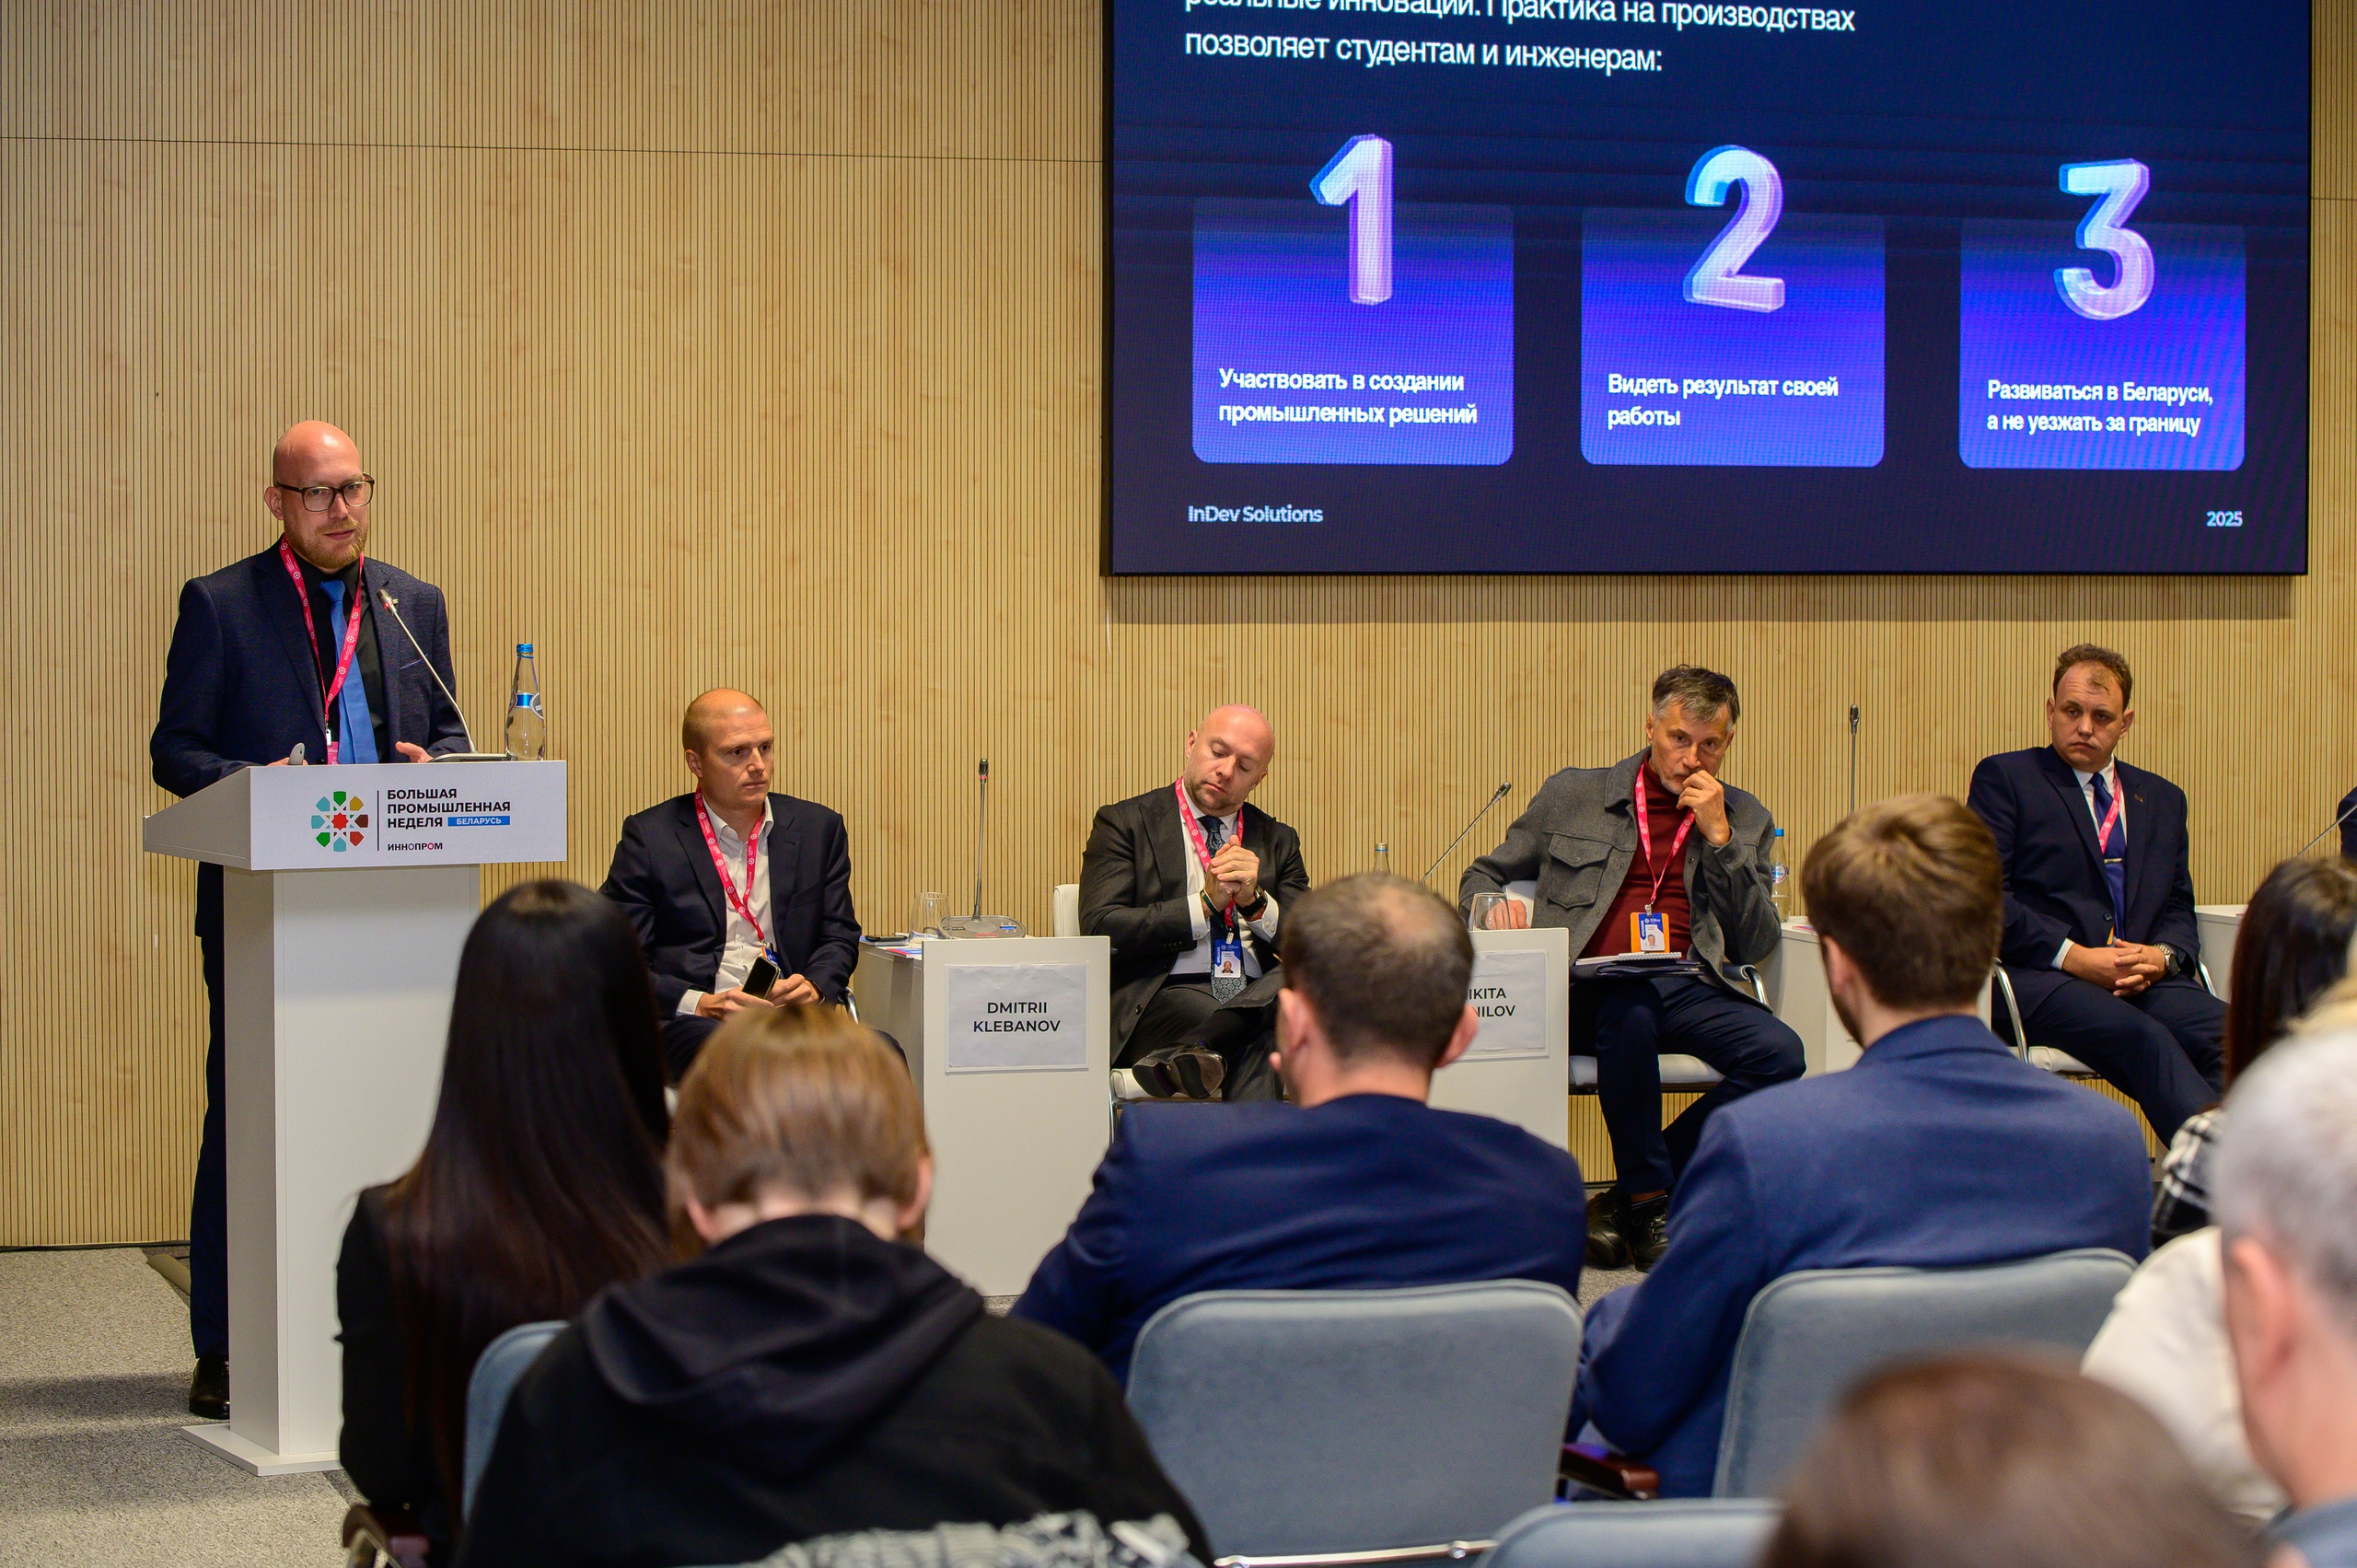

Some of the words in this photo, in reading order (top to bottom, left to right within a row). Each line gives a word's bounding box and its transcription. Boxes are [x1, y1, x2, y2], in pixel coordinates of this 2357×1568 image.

[1487, 0, 1618, 25] Практика
[1623, 0, 1655, 23] на
[1661, 2, 1855, 32] производствах
[1184, 33, 1330, 59] позволяет
[1335, 39, 1475, 68] студентам
[1481, 43, 1499, 65] и
[1504, 44, 1662, 76] инженерам:
[1309, 134, 1394, 306] 1
[1683, 145, 1785, 313] 2
[2053, 158, 2155, 320] 3
[1218, 367, 1347, 389] Участвовать
[1353, 374, 1365, 389] в
[1369, 373, 1464, 393] создании
[1608, 374, 1678, 397] Видеть
[1682, 377, 1779, 400] результат
[1782, 377, 1839, 396] своей
[1988, 379, 2103, 401] Развиваться
[2107, 384, 2119, 401] в
[2123, 382, 2213, 406] Беларуси,
[1218, 404, 1385, 425] промышленных
[1388, 403, 1478, 427] решений
[1608, 406, 1680, 430] работы
[1987, 414, 1998, 430] а
[2002, 414, 2024, 430] не
[2027, 415, 2103, 435] уезжать
[2106, 416, 2125, 431] за
[2129, 416, 2200, 437] границу
[1188, 505, 1240, 523] InDev
[1243, 504, 1323, 523] Solutions
[2206, 510, 2243, 528] 2025
[388, 788, 457, 799] БОЛЬШАЯ
[388, 801, 511, 814] ПРОМЫШЛЕННАЯ
[388, 817, 443, 829] НЕДЕЛЯ
[388, 842, 443, 851] ИННОПРОМ
[1466, 987, 1506, 1000] IKITA
[987, 1002, 1047, 1014] DMITRII
[1471, 1005, 1515, 1017] NILOV
[973, 1020, 1061, 1032] KLEBANOV
